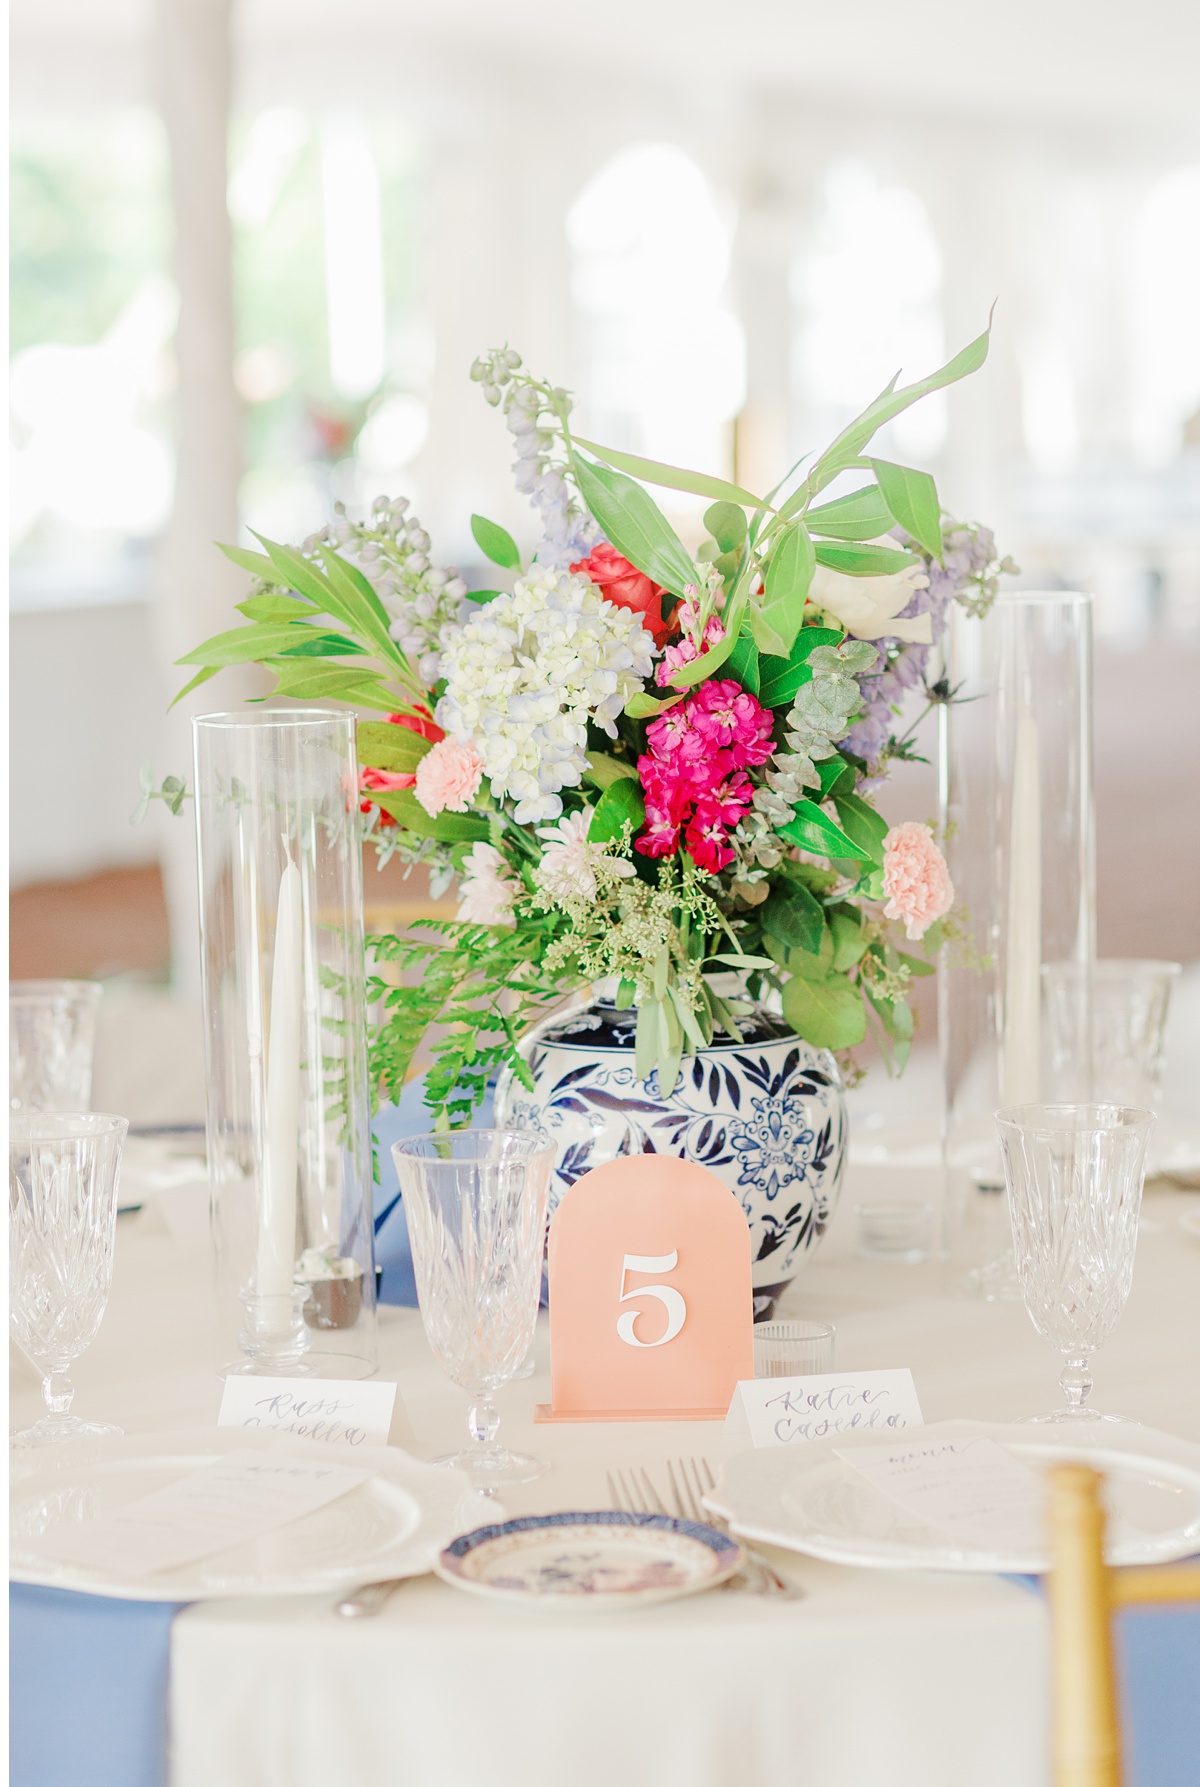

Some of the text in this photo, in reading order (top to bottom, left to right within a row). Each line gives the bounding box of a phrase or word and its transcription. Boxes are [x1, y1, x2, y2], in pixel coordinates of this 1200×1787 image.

[616, 1248, 687, 1348] 5
[254, 1392, 356, 1420] Russ
[765, 1384, 890, 1415] Katie
